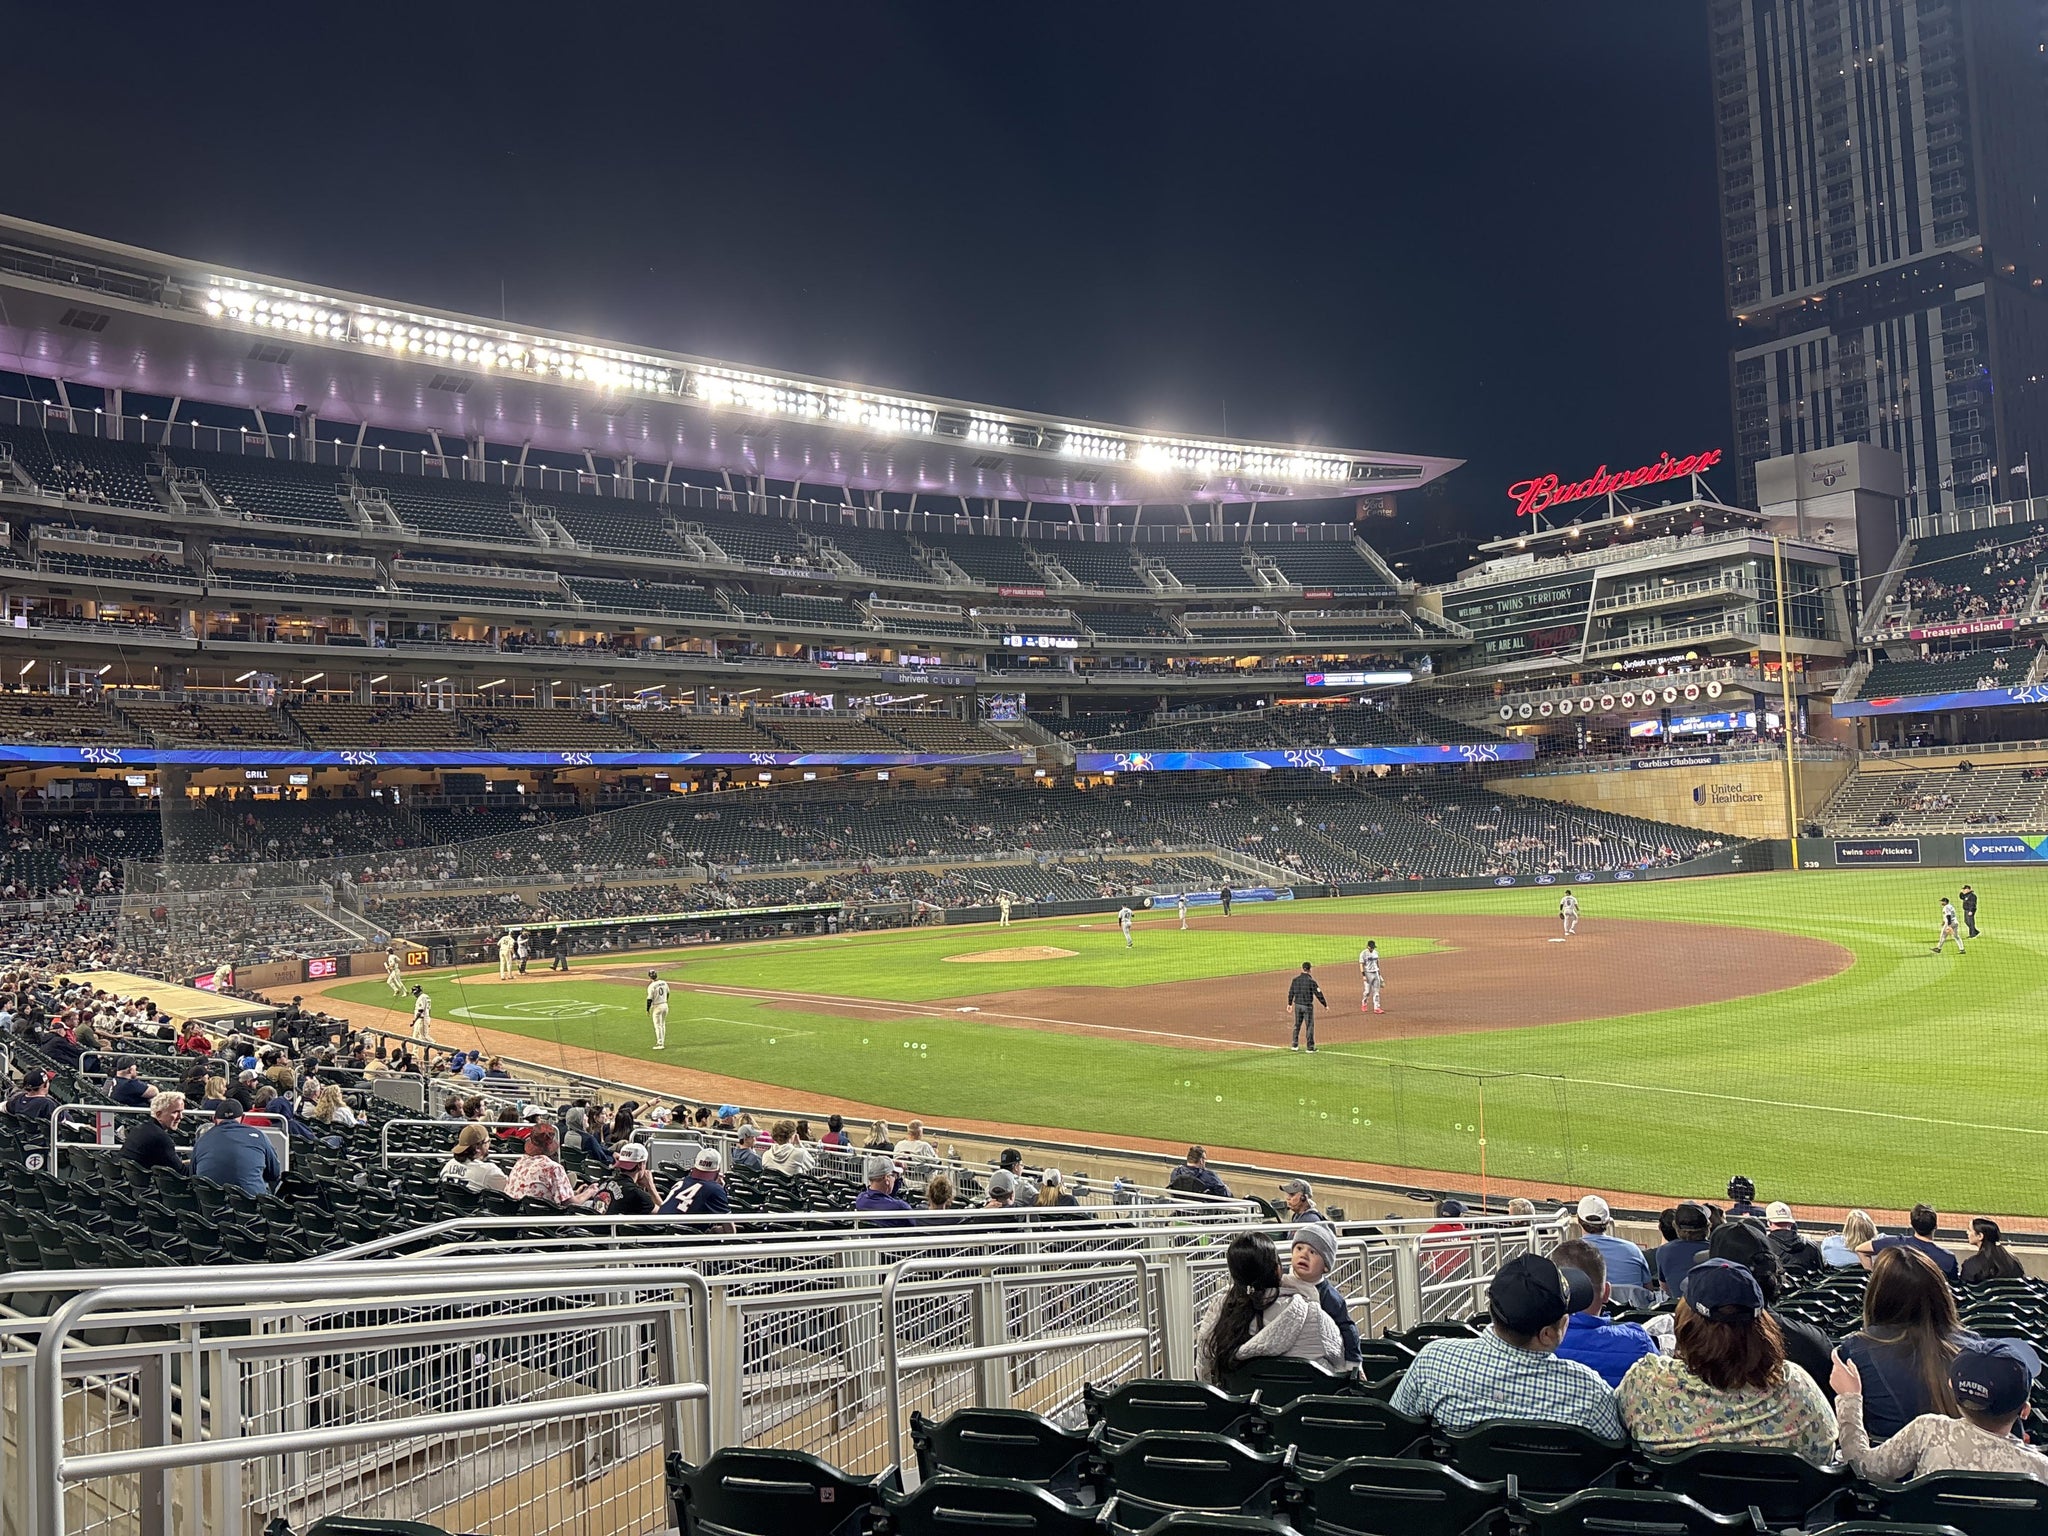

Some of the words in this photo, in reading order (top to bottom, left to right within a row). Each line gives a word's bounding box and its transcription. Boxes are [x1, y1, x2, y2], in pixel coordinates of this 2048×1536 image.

[1507, 449, 1722, 517] Budweiser
[1362, 497, 1384, 510] Ford
[1458, 606, 1482, 617] WELCOME
[1496, 597, 1524, 612] TWINS
[1528, 588, 1572, 605] TERRITORY
[1921, 626, 1968, 638] Treasure
[1970, 621, 2004, 633] Island
[1485, 640, 1497, 652] WE
[1498, 638, 1512, 651] ARE
[1512, 636, 1525, 649] ALL
[899, 674, 929, 684] thrivent
[1638, 758, 1669, 769] Carbliss
[1670, 756, 1712, 766] Clubhouse
[245, 770, 269, 779] GRILL
[1711, 783, 1742, 794] United
[1712, 792, 1763, 804] Healthcare
[1842, 846, 1913, 856] twins.com/tickets
[1981, 845, 2025, 853] PENTAIR
[658, 987, 664, 996] 0
[449, 1164, 467, 1177] LEWIS
[1959, 1381, 1989, 1394] MAUER
